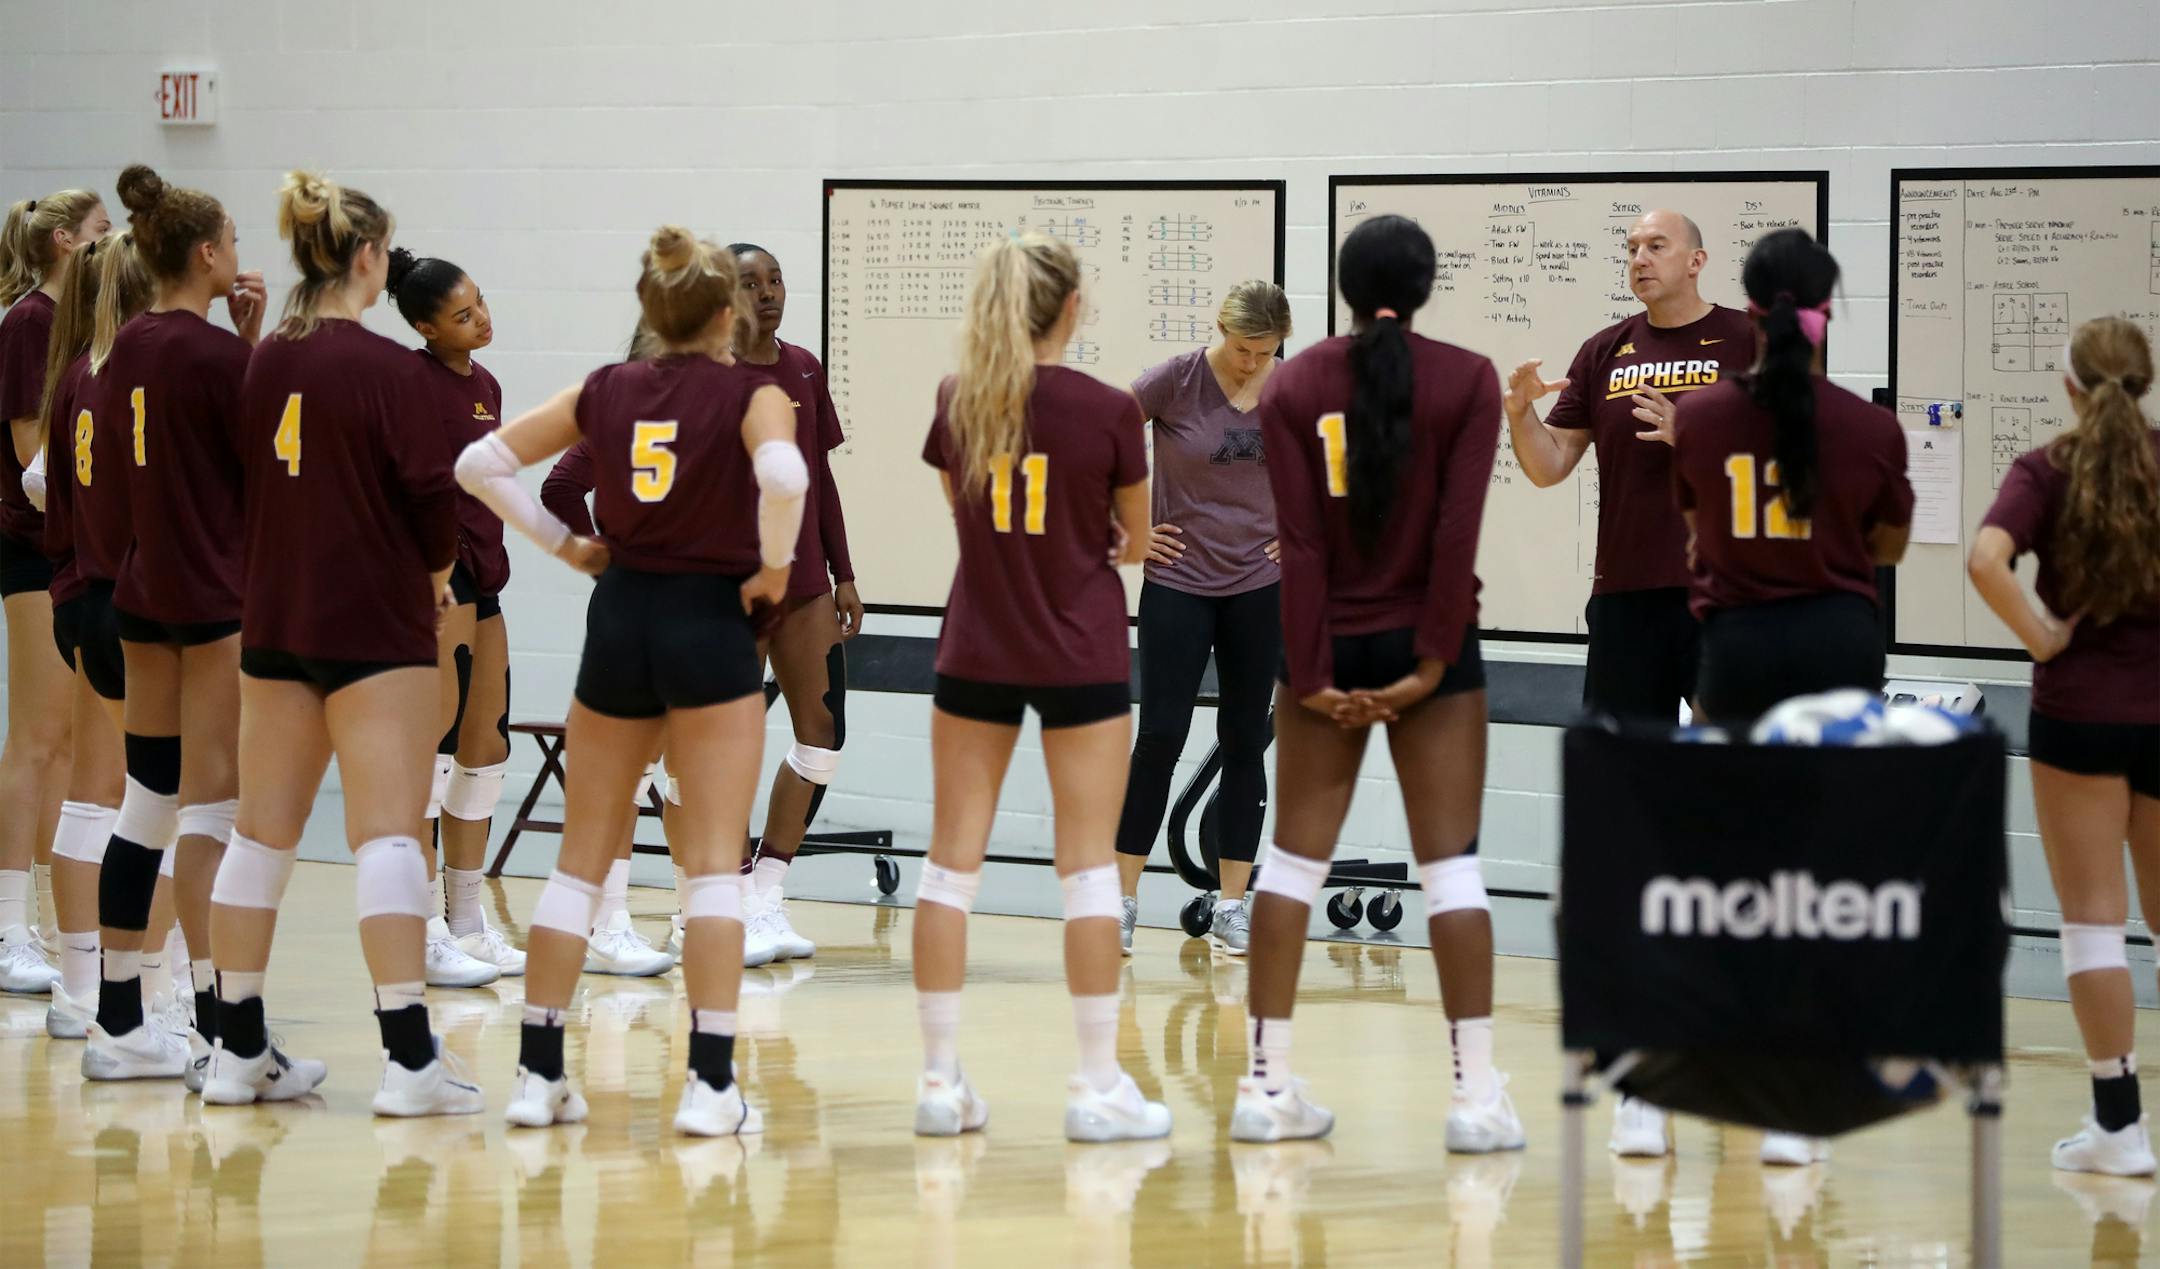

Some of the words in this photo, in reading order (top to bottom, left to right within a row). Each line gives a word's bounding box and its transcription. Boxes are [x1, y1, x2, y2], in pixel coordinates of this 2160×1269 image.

[161, 72, 199, 120] EXIT
[1493, 203, 1526, 214] MIDDLES
[1528, 187, 1571, 199] VITAMINS
[1900, 187, 1957, 198] ANNOUNCEMENTS
[1506, 313, 1531, 329] Activity
[1608, 359, 1720, 393] GOPHERS
[131, 387, 147, 467] 1
[273, 393, 302, 477] 4
[1901, 402, 1926, 412] STATS
[75, 408, 94, 487] 8
[631, 420, 679, 502] 5
[988, 452, 1049, 535] 11
[1724, 453, 1812, 539] 12
[1640, 869, 1922, 940] molten
